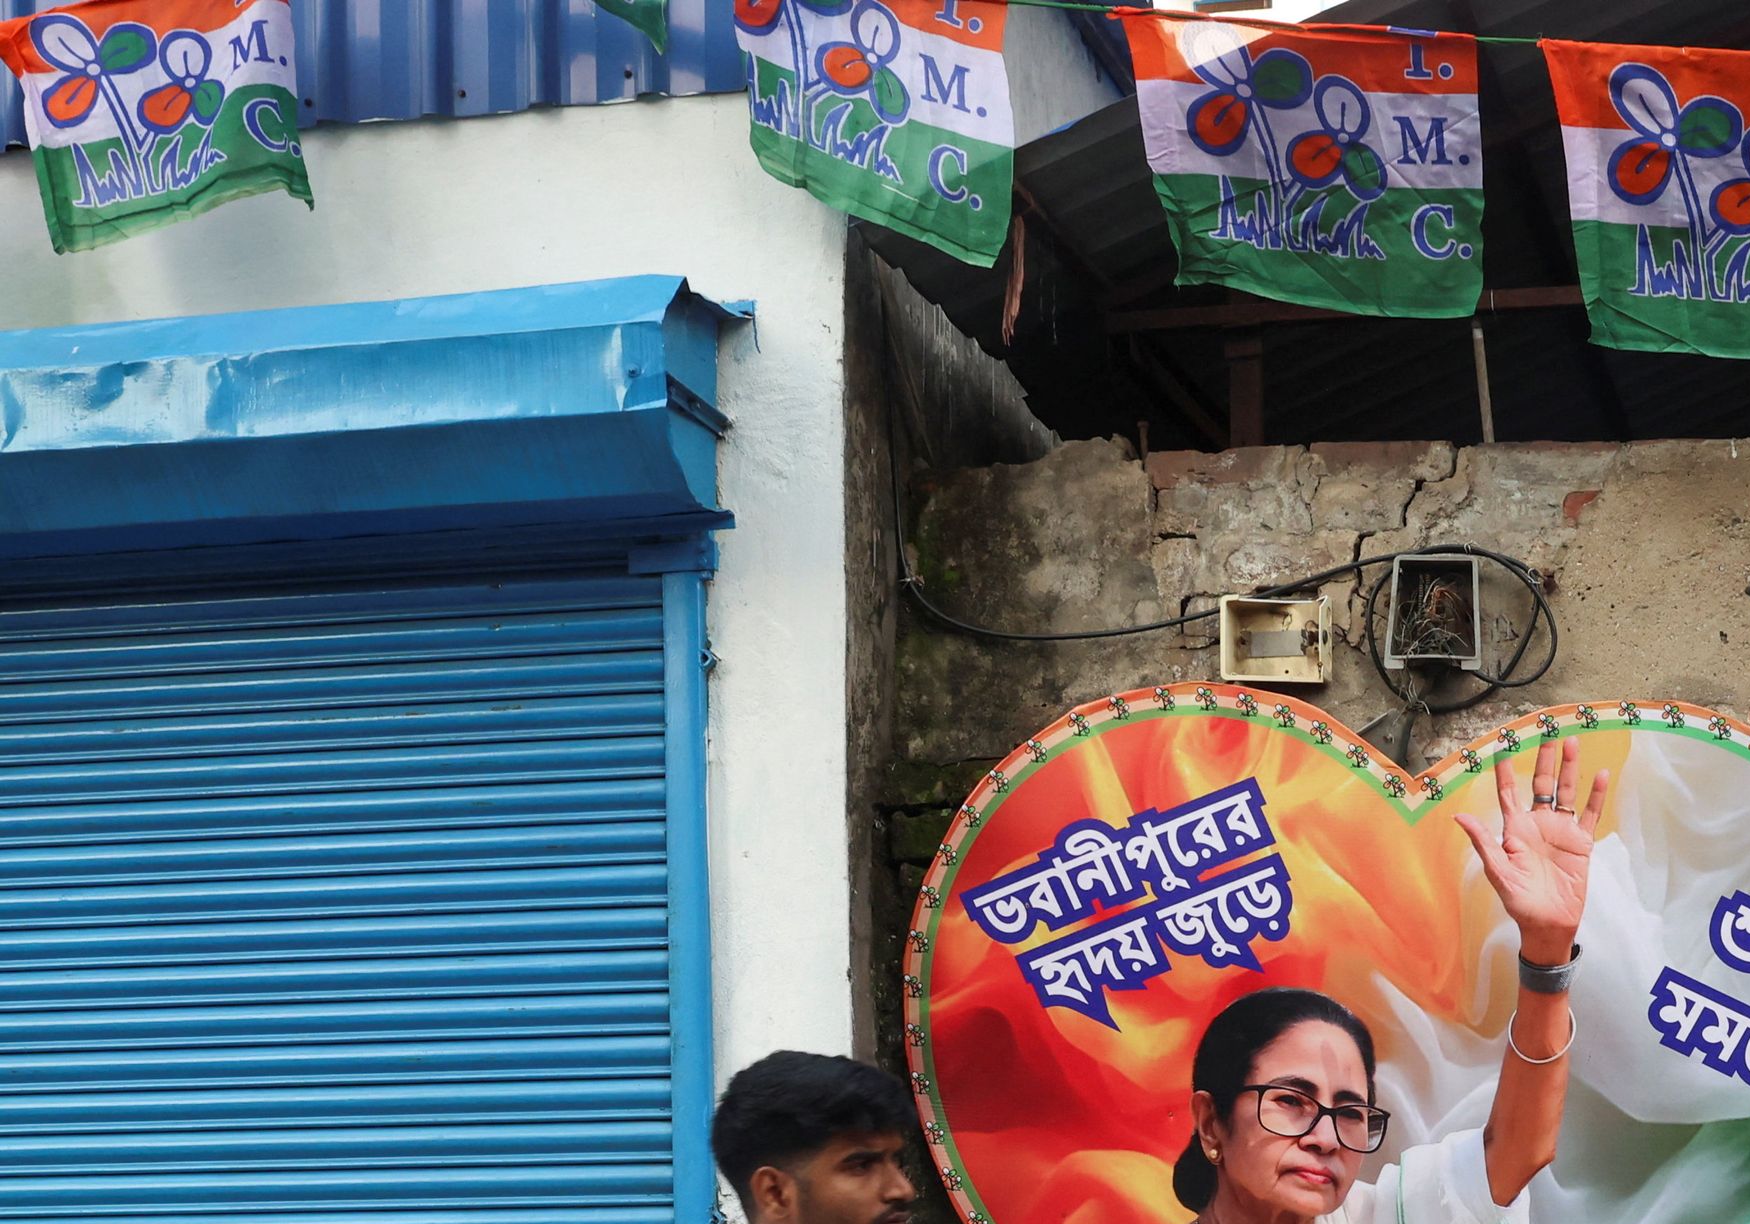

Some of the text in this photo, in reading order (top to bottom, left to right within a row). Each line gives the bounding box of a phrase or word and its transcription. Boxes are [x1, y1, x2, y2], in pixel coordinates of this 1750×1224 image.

[229, 19, 288, 73] M.
[919, 53, 988, 118] M.
[243, 98, 301, 157] C.
[1393, 116, 1470, 165] M.
[928, 144, 982, 211] C.
[1411, 204, 1473, 260] C.
[973, 790, 1262, 935] ভবানীপুরের
[1029, 866, 1283, 1005] হৃদয় জুড়ে
